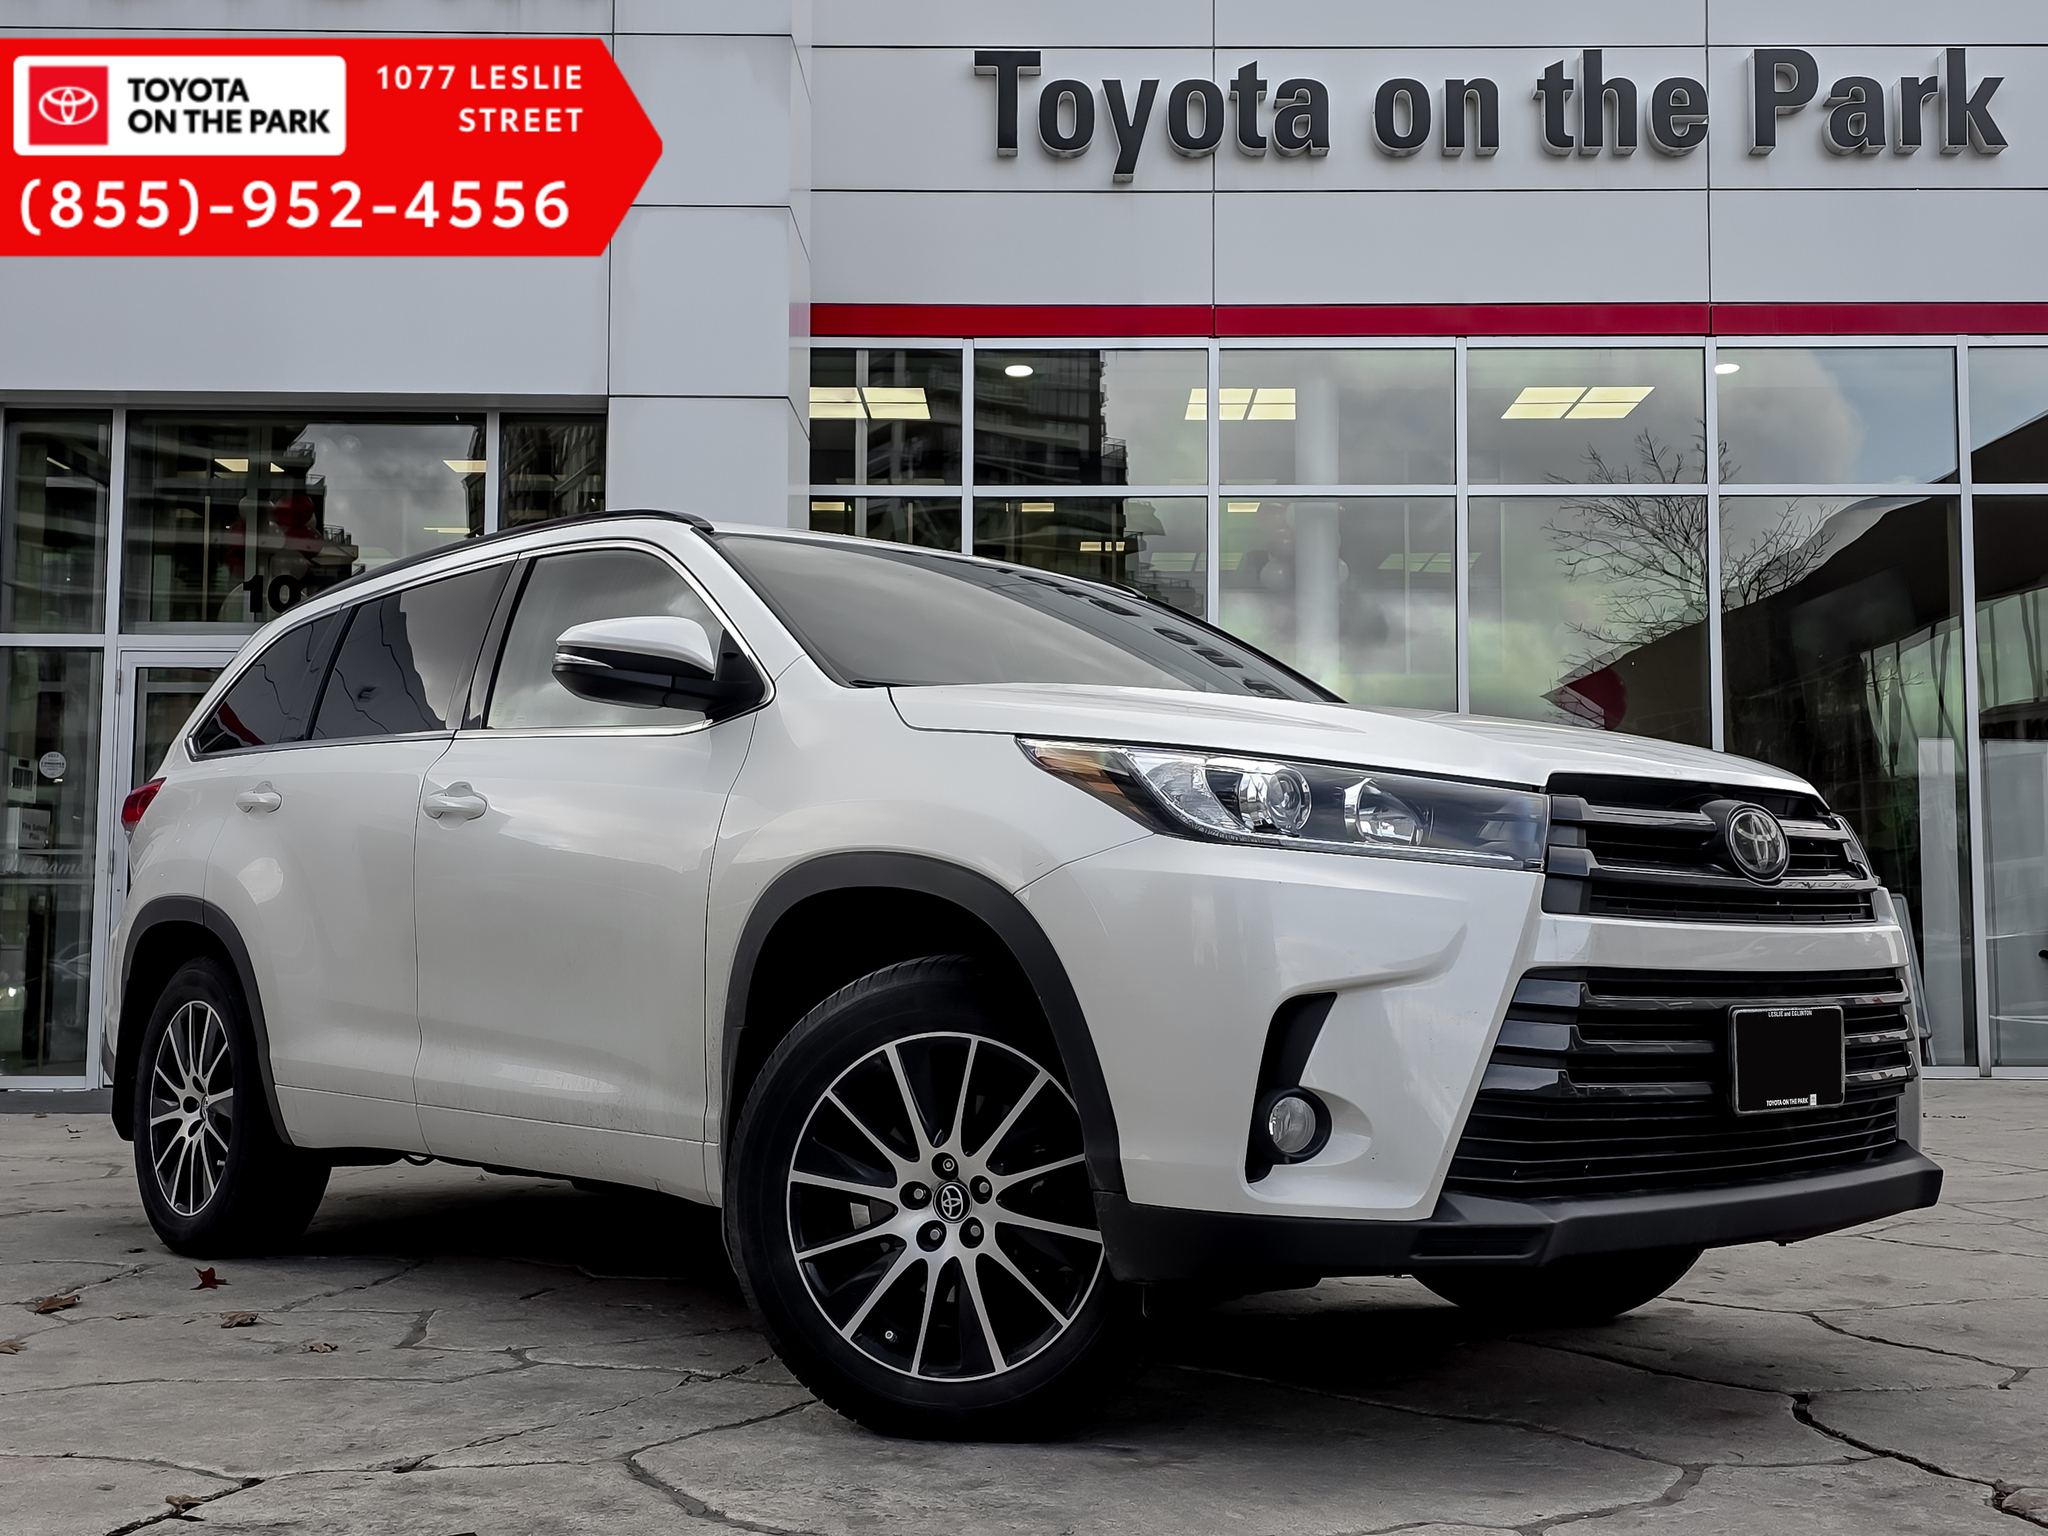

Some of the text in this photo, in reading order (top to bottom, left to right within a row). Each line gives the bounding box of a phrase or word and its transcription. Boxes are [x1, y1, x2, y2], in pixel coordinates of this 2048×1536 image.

[975, 47, 2007, 182] Toyota on the Park
